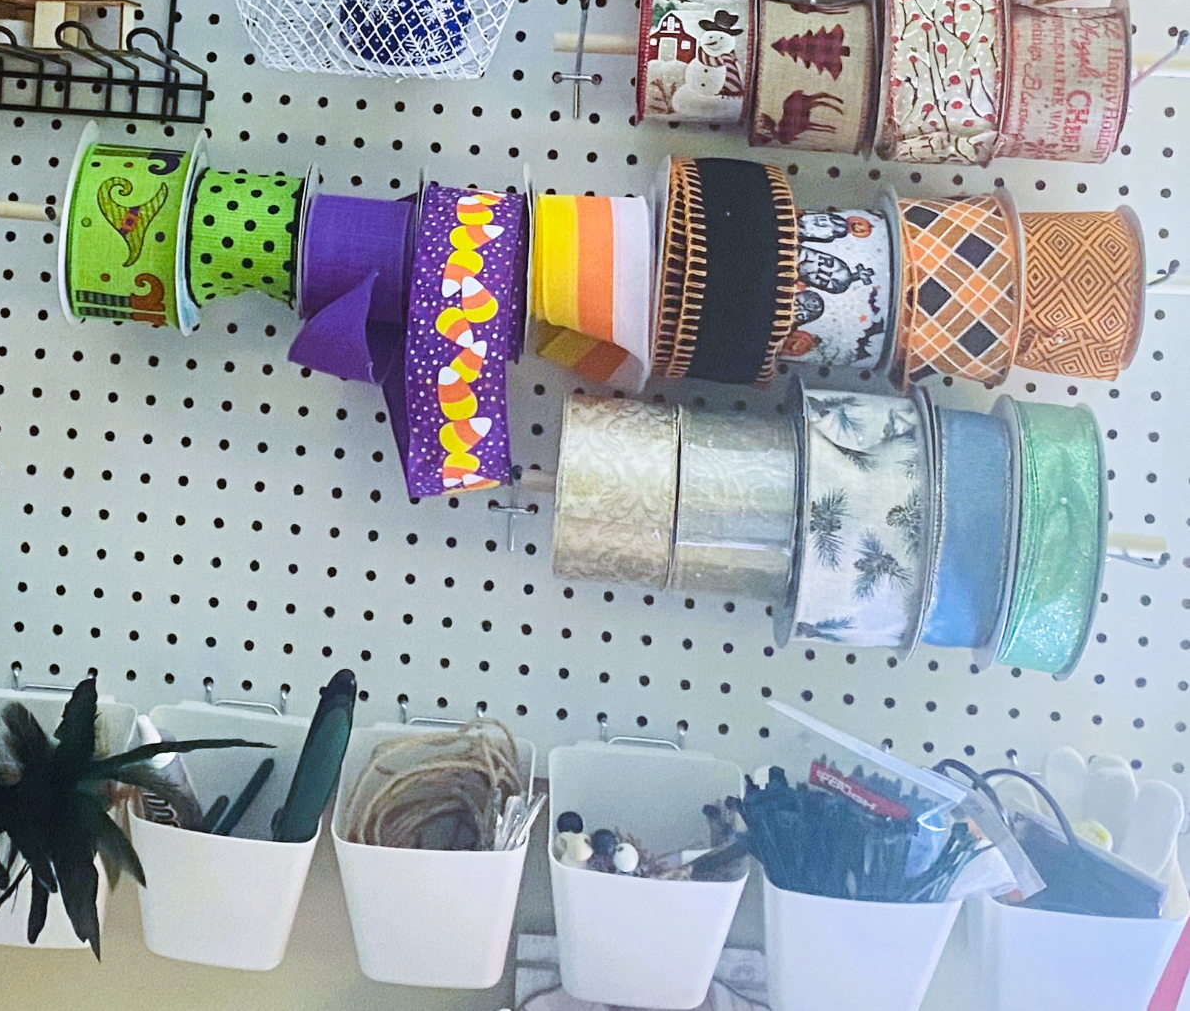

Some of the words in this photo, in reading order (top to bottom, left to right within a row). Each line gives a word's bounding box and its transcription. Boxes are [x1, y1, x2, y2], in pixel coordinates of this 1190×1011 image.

[1101, 47, 1124, 106] Happy
[1060, 89, 1093, 154] CHEER
[814, 255, 835, 288] RIP
